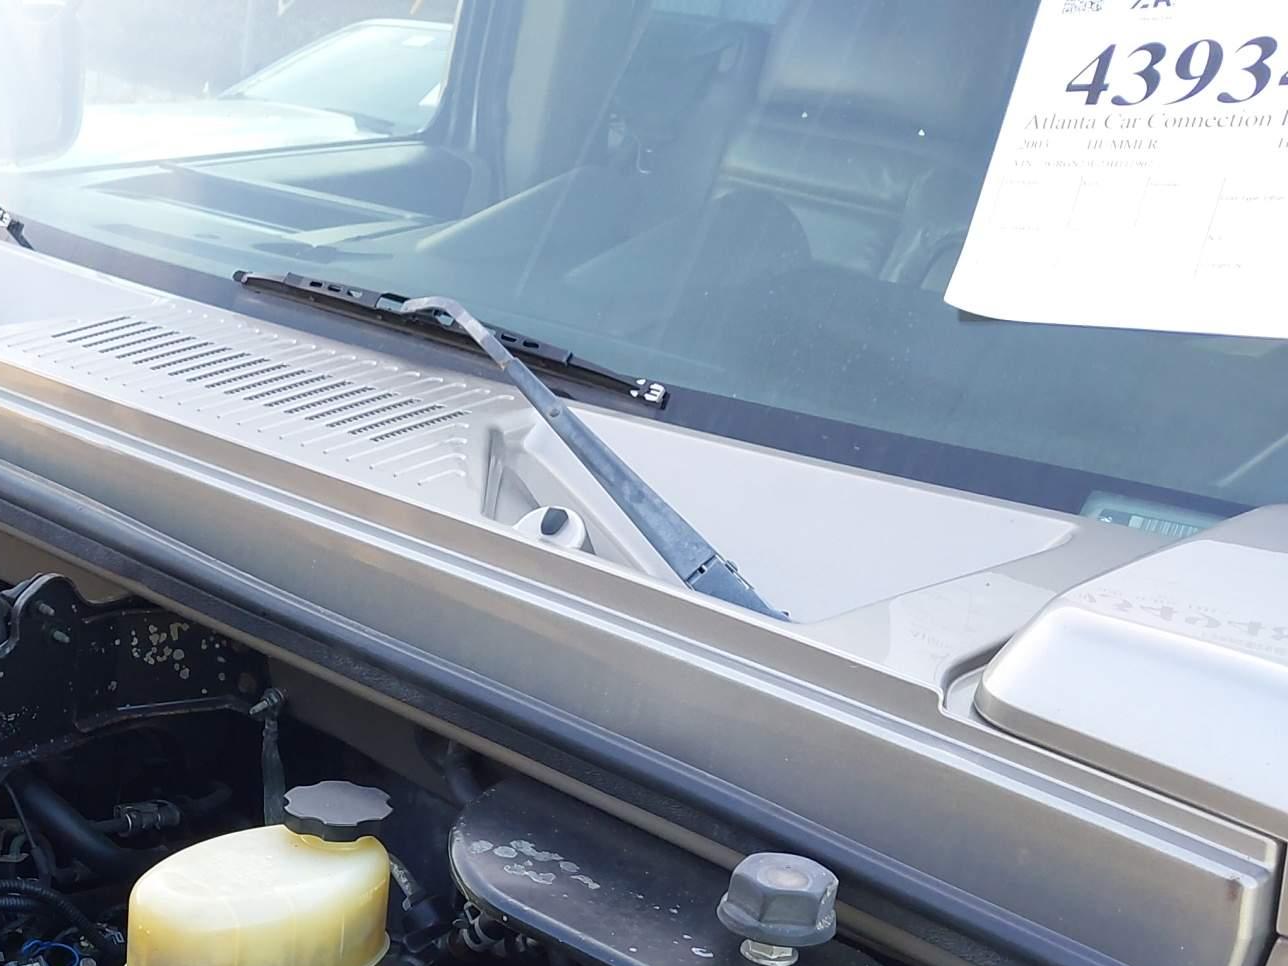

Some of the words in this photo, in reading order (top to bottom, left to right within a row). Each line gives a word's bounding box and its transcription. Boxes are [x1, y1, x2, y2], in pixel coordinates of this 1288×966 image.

[1065, 36, 1288, 106] 4393
[1024, 112, 1097, 130] Atlanta
[1104, 111, 1141, 129] Car
[1148, 108, 1272, 129] Connection
